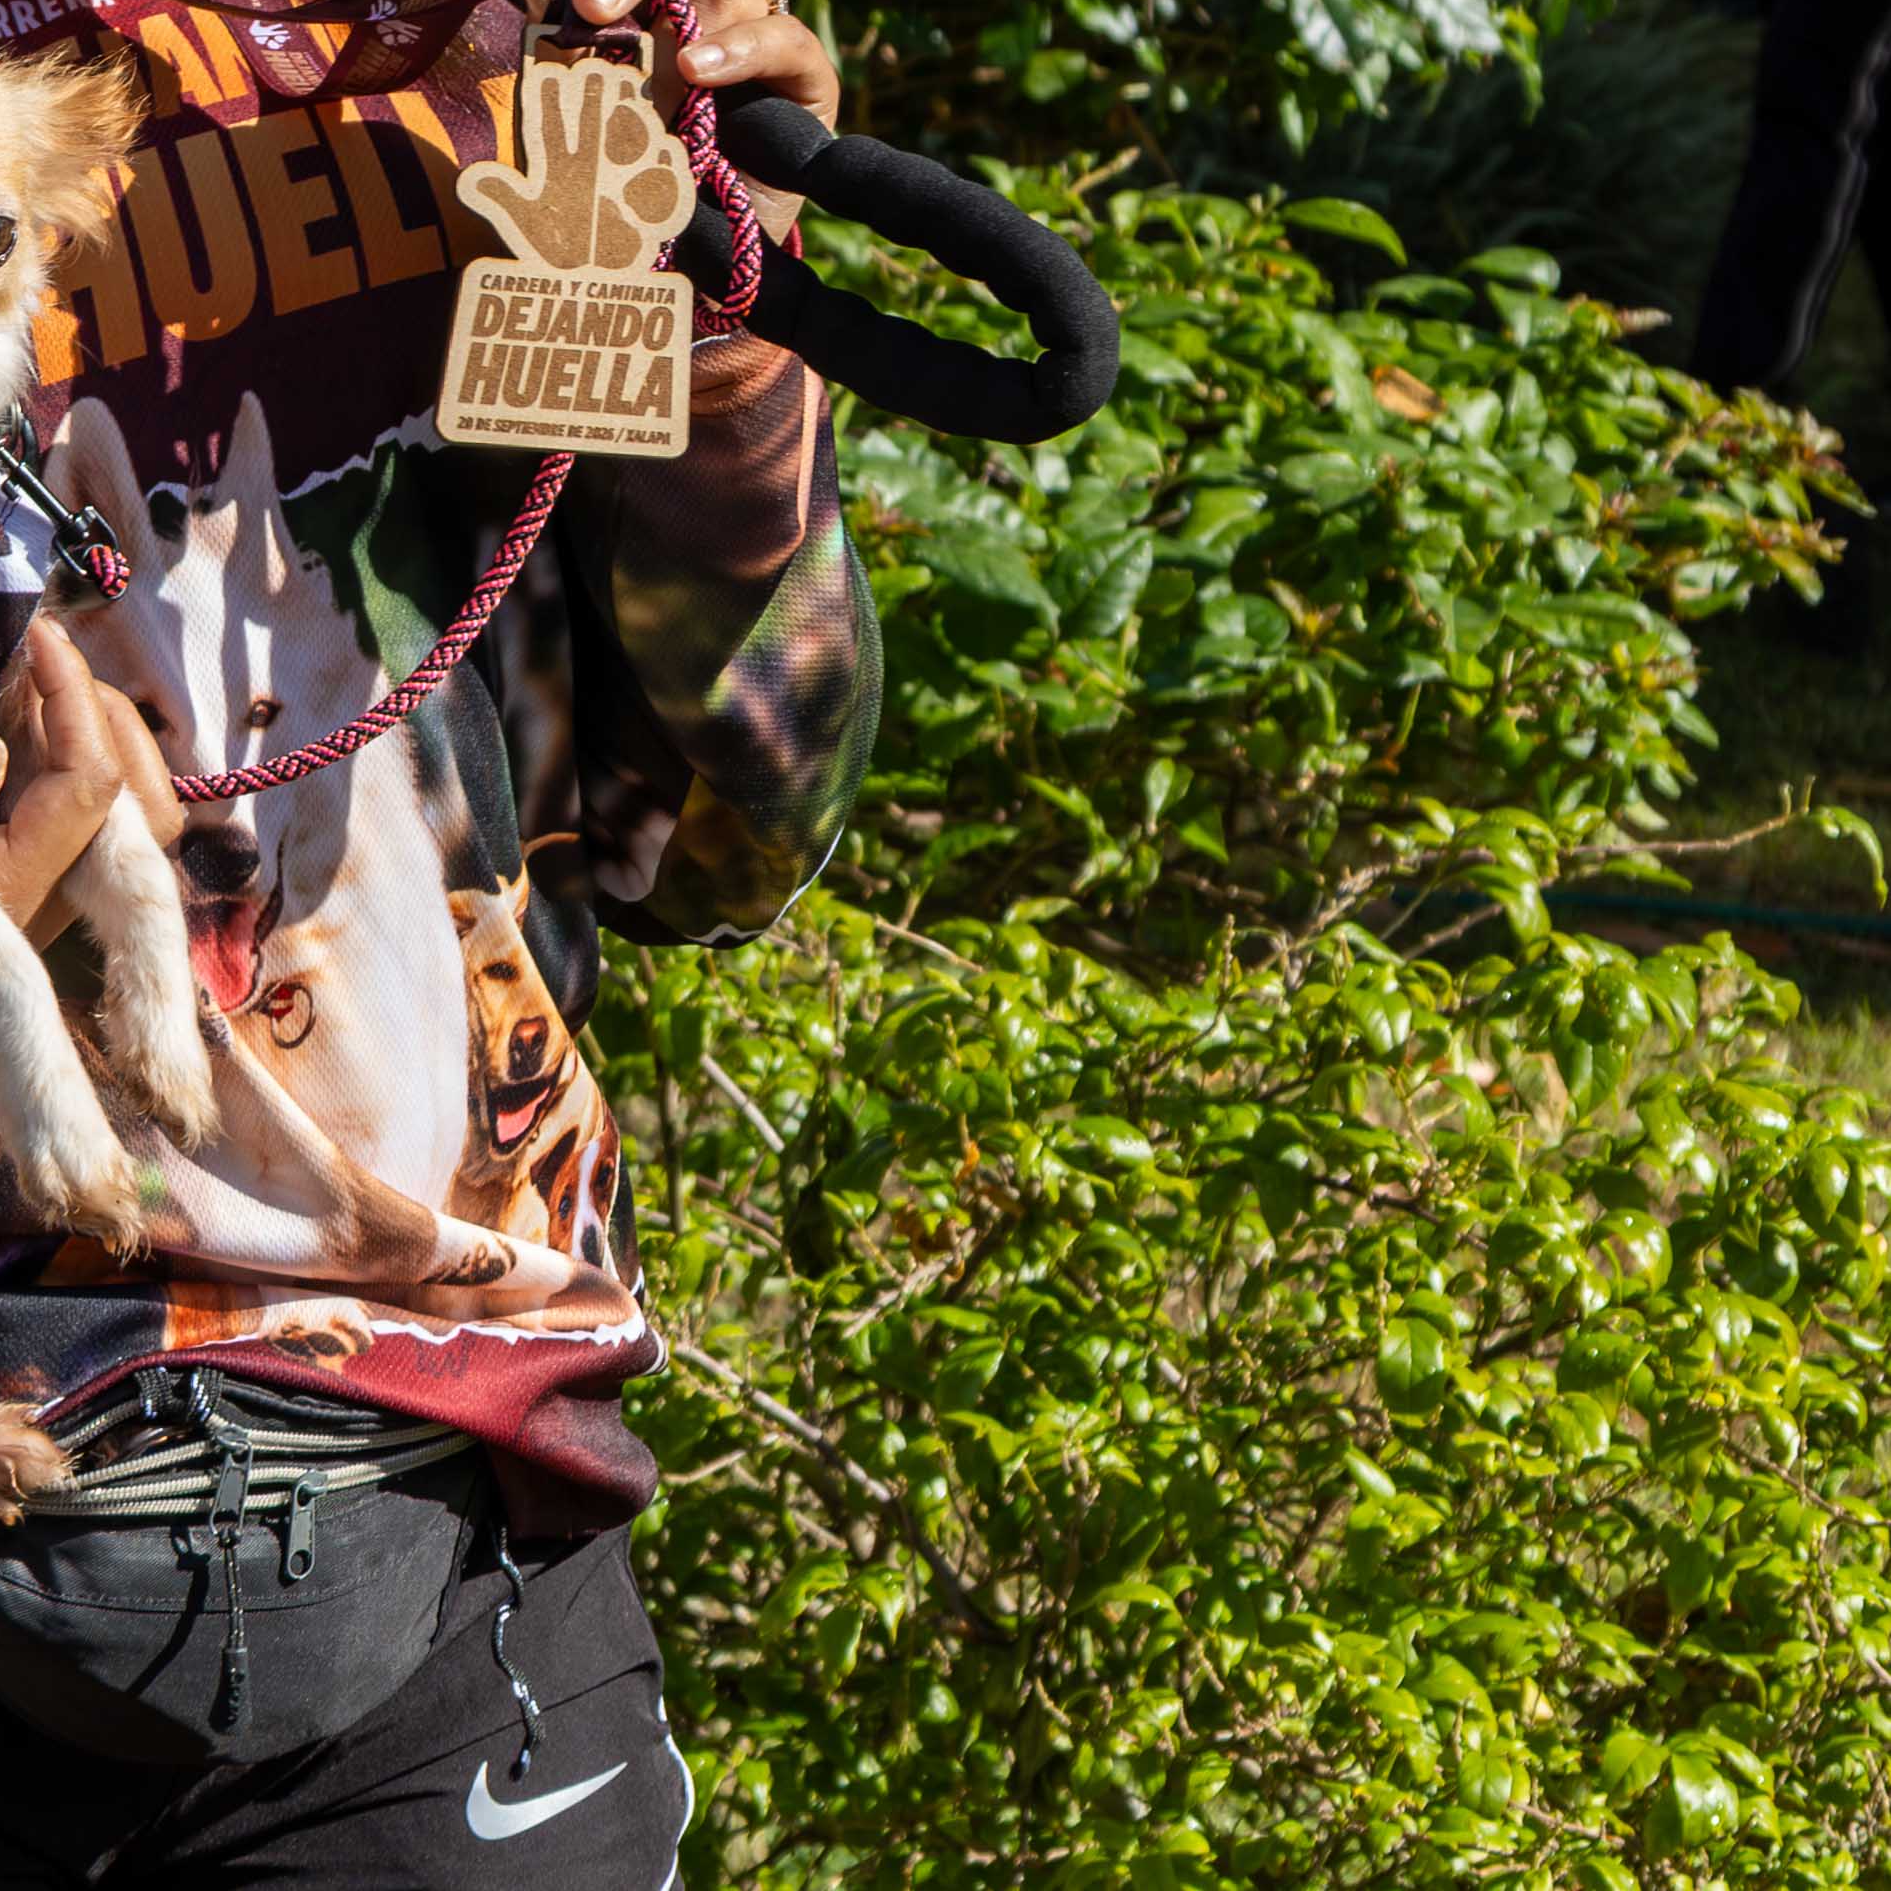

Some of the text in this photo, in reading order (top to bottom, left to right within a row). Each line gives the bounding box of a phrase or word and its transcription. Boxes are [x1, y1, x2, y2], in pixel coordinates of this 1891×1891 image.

[32, 70, 521, 387] HUELL
[480, 273, 676, 305] CARRERA Y CAMINATA
[470, 293, 675, 351] DEJANDO
[457, 341, 674, 419] HUELLA
[474, 418, 493, 432] DE
[492, 418, 565, 437] SEPTIEMBRE
[567, 424, 585, 439] DE
[626, 428, 672, 446] XALAPA
